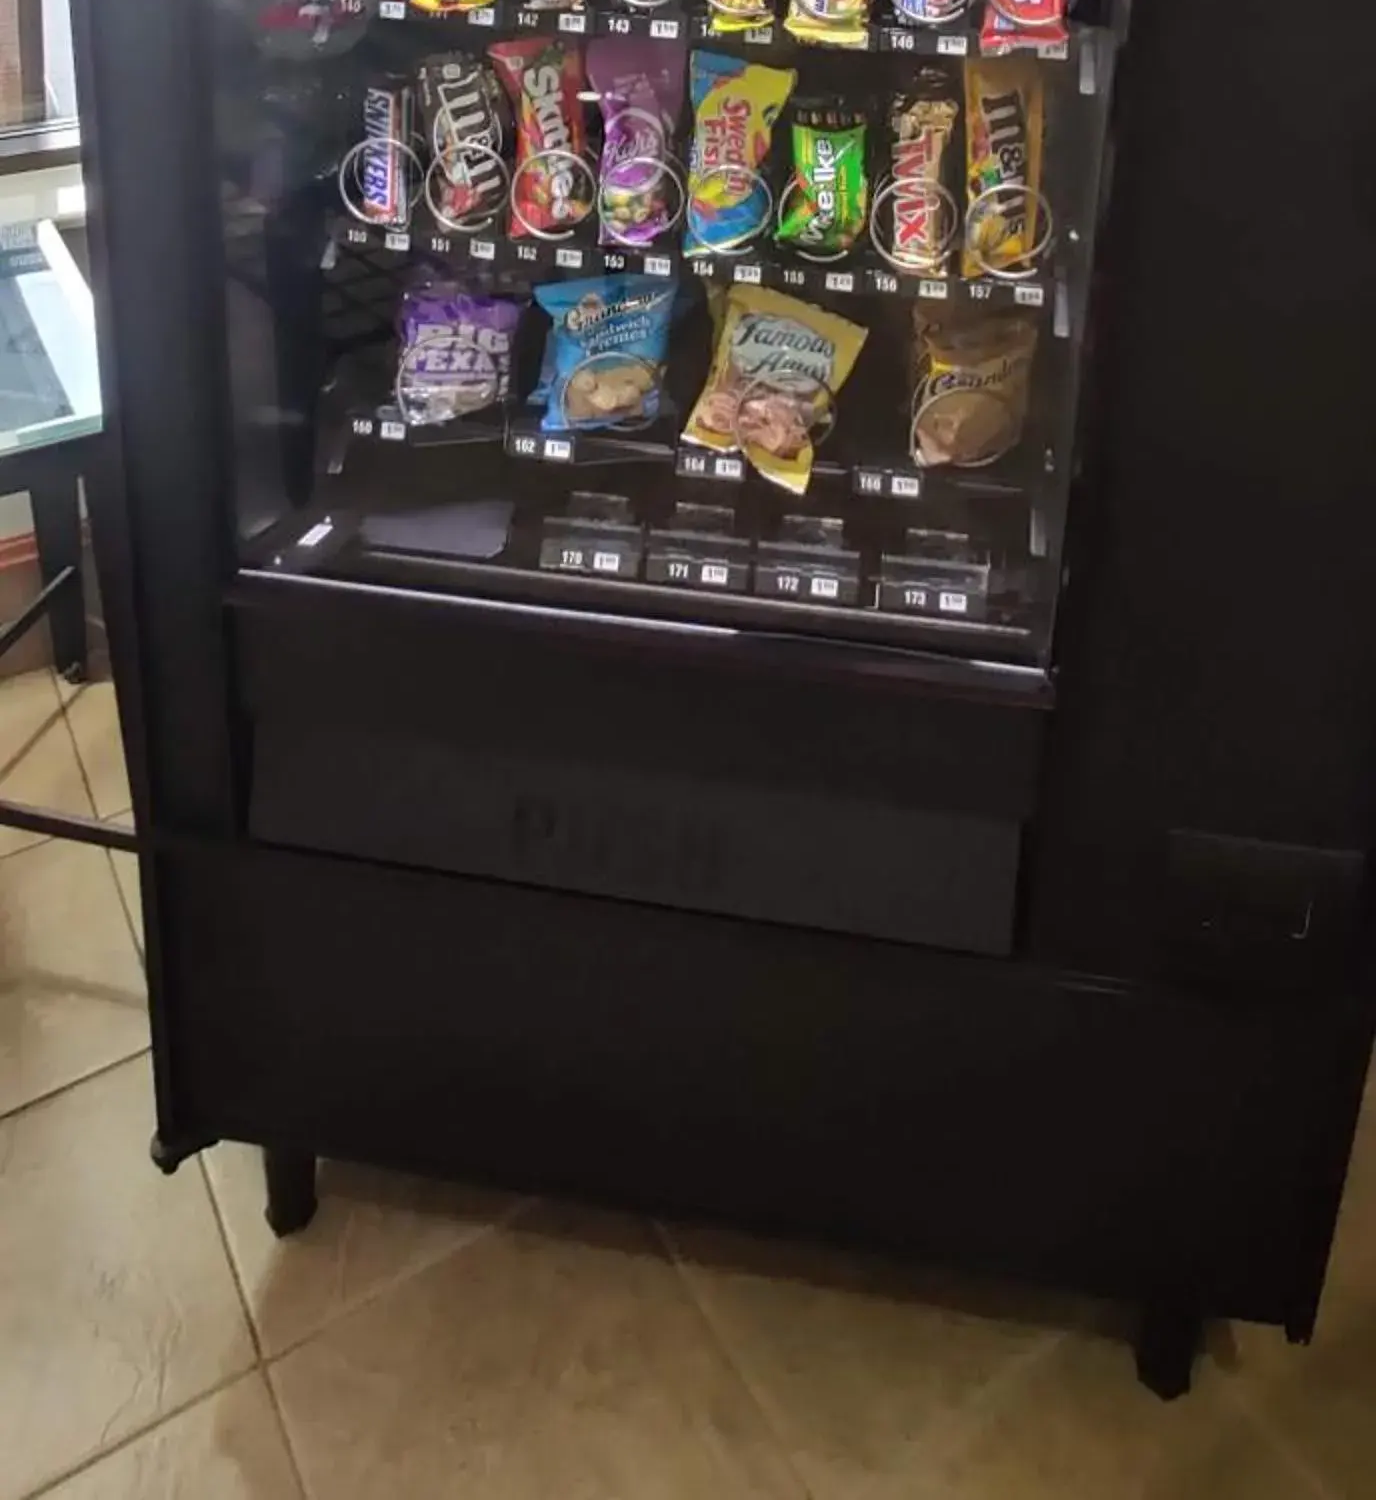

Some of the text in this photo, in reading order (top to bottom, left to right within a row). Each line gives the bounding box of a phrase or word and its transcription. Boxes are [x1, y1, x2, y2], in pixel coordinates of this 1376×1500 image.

[417, 323, 509, 353] BIG
[736, 314, 836, 359] Famous
[668, 563, 689, 578] 171
